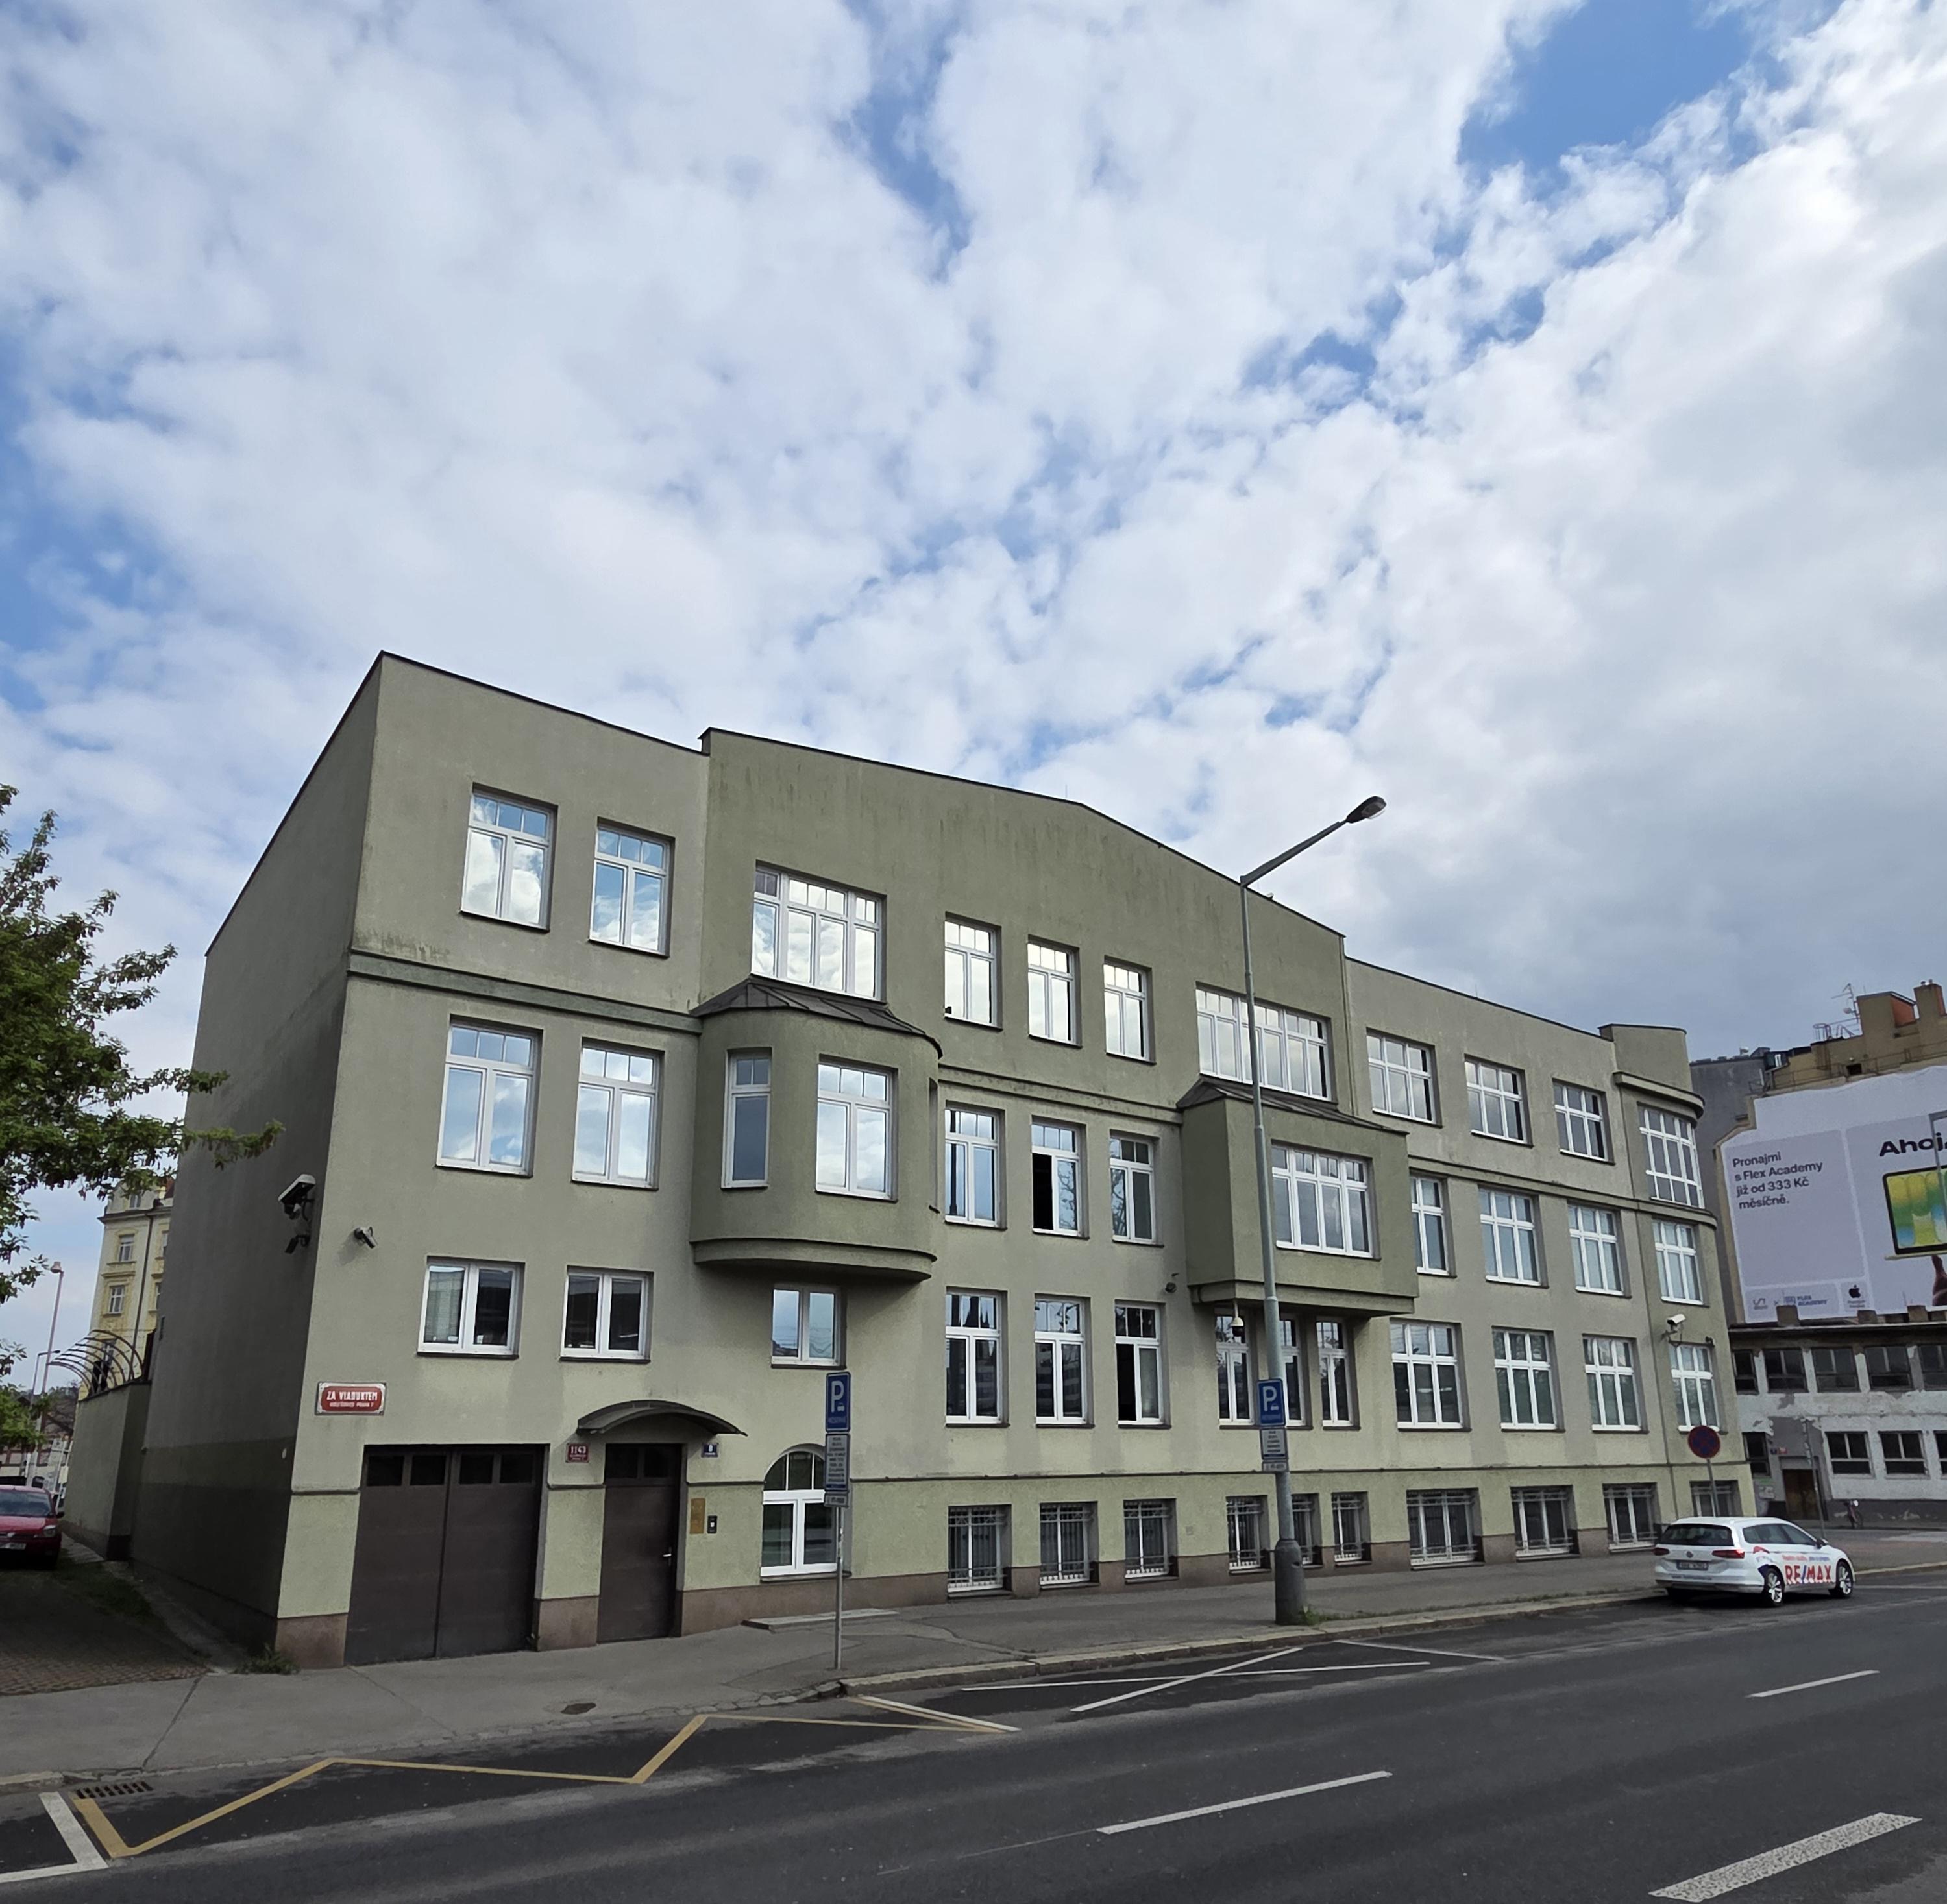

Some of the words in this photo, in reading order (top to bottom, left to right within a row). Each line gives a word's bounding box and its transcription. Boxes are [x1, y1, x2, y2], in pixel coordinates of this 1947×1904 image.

[1732, 1151, 1782, 1168] Pronajmi
[1735, 1173, 1742, 1182] s
[1743, 1170, 1767, 1180] Flex
[1769, 1162, 1823, 1177] Academy
[1736, 1184, 1749, 1198] již
[1750, 1183, 1765, 1193] od
[1767, 1179, 1791, 1191] 333
[1793, 1176, 1810, 1188] Kč
[1739, 1193, 1790, 1210] měsíčně.
[326, 1391, 336, 1400] ZA
[339, 1391, 378, 1401] VIADUKTEM
[831, 1380, 844, 1413] P
[1262, 1385, 1277, 1412] P
[1784, 1565, 1831, 1584] RE/MAX
